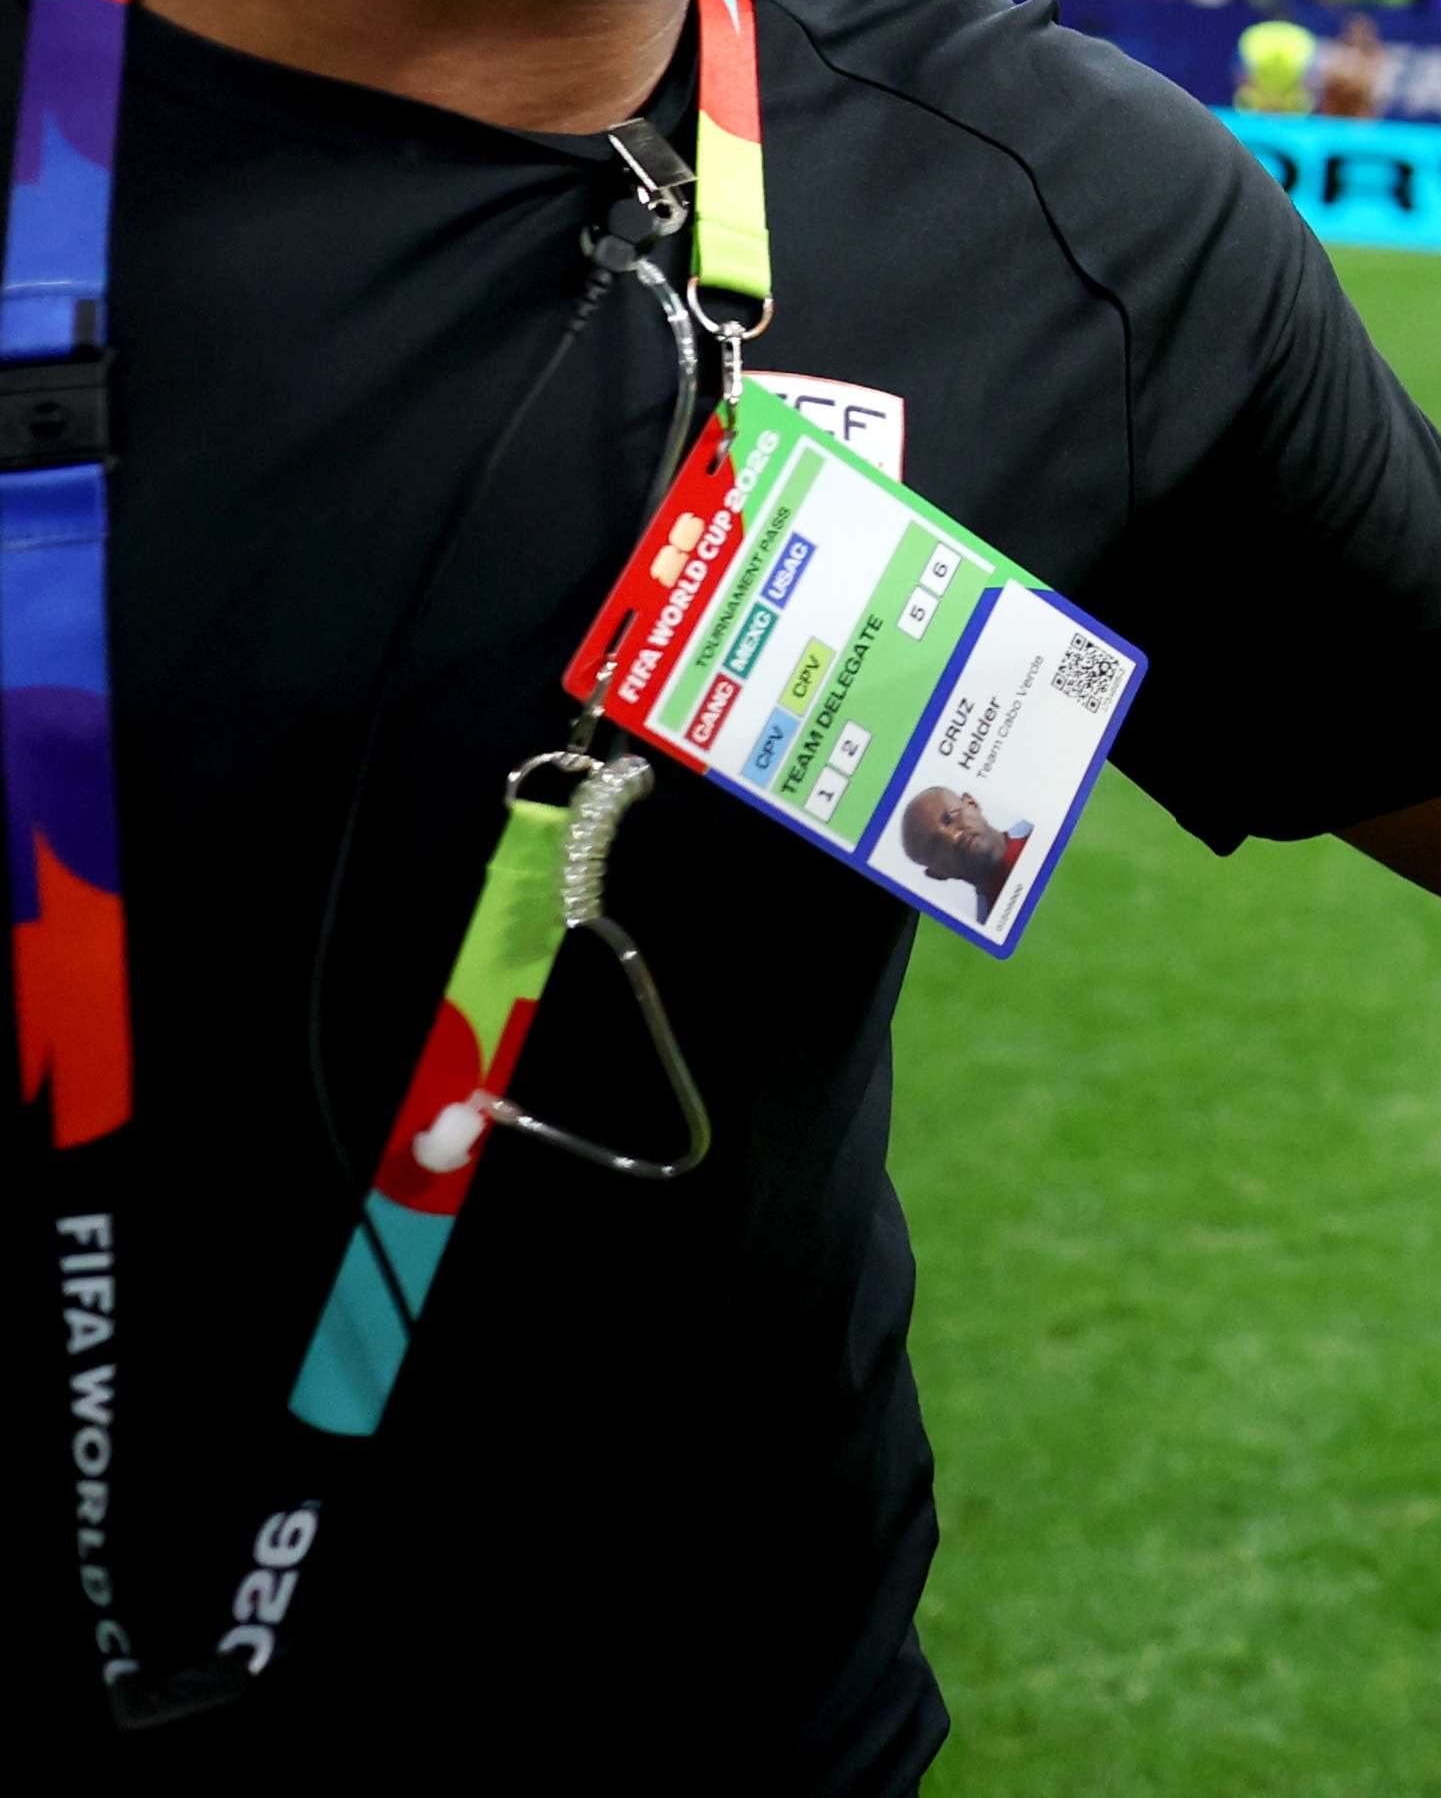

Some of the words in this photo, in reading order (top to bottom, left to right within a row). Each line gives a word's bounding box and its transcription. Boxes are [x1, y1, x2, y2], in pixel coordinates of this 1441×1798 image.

[776, 393, 886, 440] CF
[618, 649, 662, 704] FIFA
[648, 559, 708, 647] WORLD
[697, 510, 732, 562] CUP
[724, 430, 780, 514] 2026
[696, 555, 763, 667] TOURNAMENT
[761, 506, 791, 553] PASS
[756, 725, 785, 770] CPV
[792, 654, 821, 699] CPV
[781, 730, 822, 794] TEAM
[818, 613, 883, 730] DELEGATE
[816, 788, 835, 803] 1
[841, 739, 859, 757] 2
[909, 605, 927, 622] 5
[932, 562, 948, 578] 6
[938, 698, 975, 757] CRUZ
[958, 696, 1001, 770] Helder
[977, 739, 1003, 780] Team
[999, 701, 1022, 739] Cabo
[1016, 655, 1044, 701] Verde
[56, 1213, 115, 1354] FIFA
[68, 1361, 116, 1607] WORLD
[95, 1618, 142, 1685] CU
[217, 1508, 318, 1675] 026
